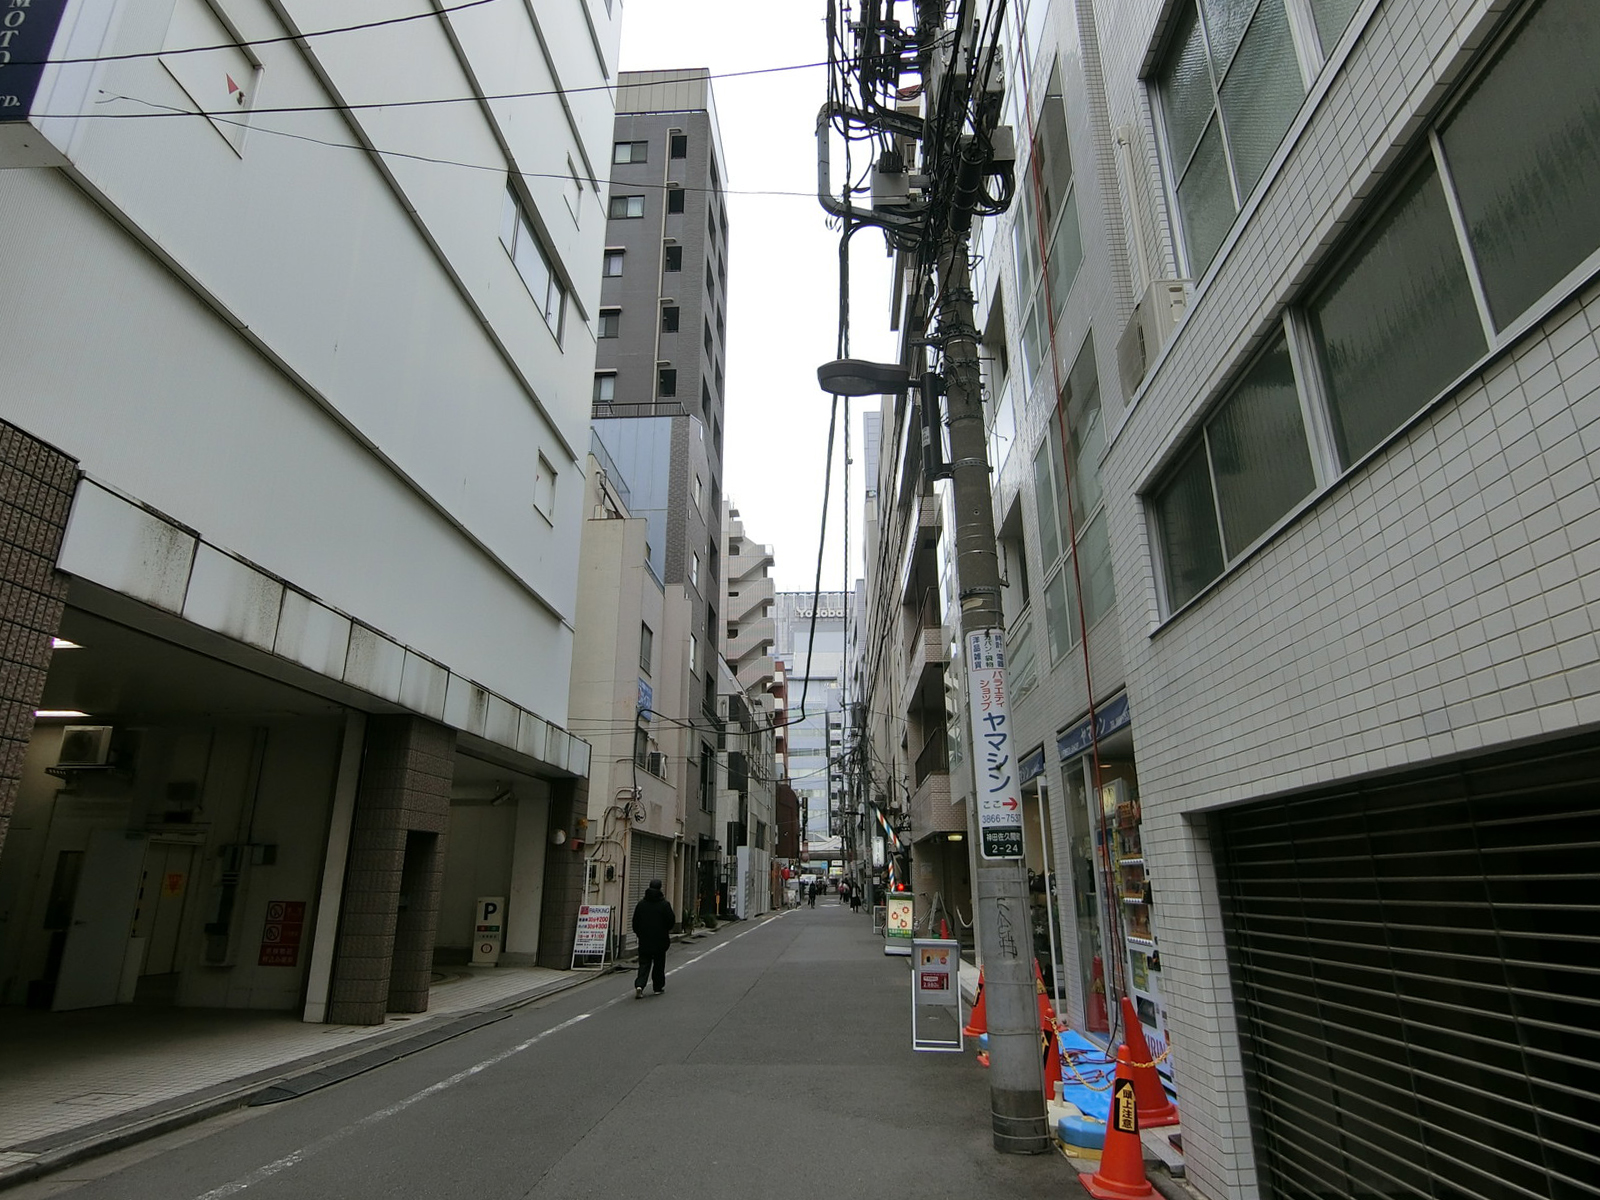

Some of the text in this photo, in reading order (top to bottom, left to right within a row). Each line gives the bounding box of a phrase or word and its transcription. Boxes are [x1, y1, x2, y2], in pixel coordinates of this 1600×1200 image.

[972, 636, 982, 669] 洋品雑貨
[980, 680, 992, 711] ショップ
[992, 671, 1005, 708] バラエティ
[983, 712, 1011, 793] ヤマシン
[983, 800, 1001, 809] ここ
[991, 844, 1018, 853] 2-24
[483, 902, 498, 921] P
[1145, 1033, 1168, 1064] IRIN
[1122, 1088, 1133, 1129] 頭上注意
